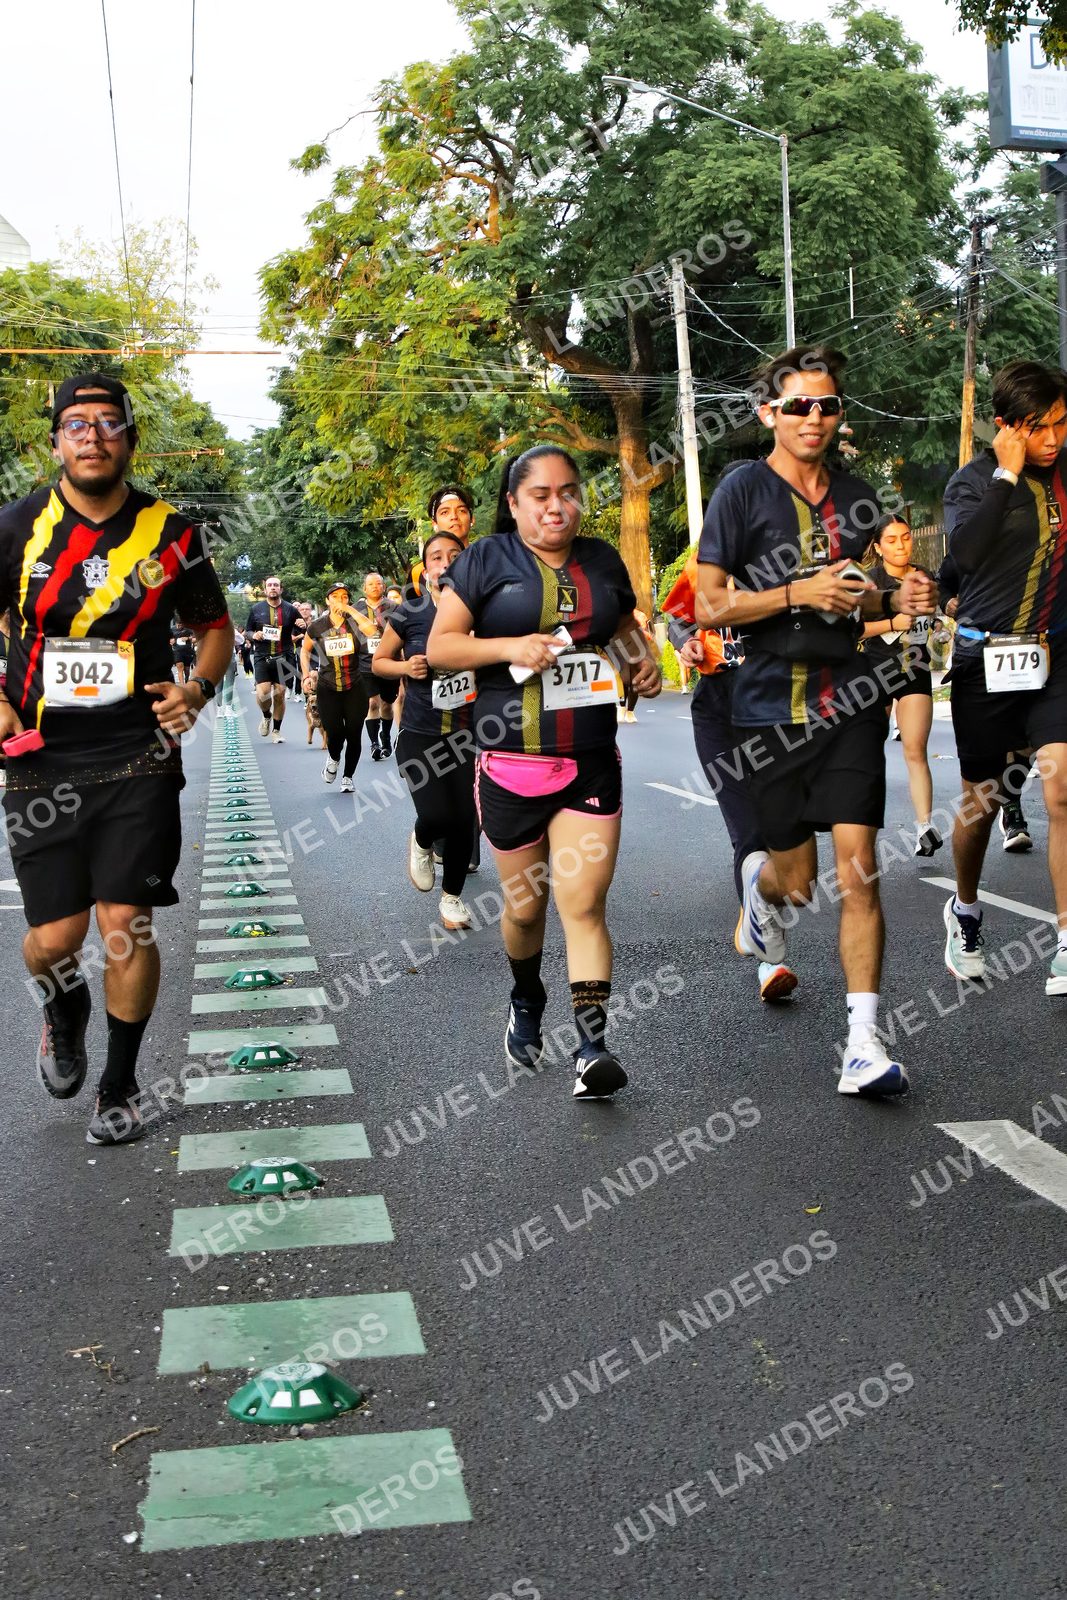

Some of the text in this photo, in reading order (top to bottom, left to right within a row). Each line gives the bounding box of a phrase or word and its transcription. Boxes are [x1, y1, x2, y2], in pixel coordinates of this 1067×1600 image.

[329, 641, 347, 650] 6702
[994, 651, 1040, 671] 7179
[56, 662, 113, 684] 3042
[551, 660, 601, 686] 3717
[439, 677, 469, 698] 2122
